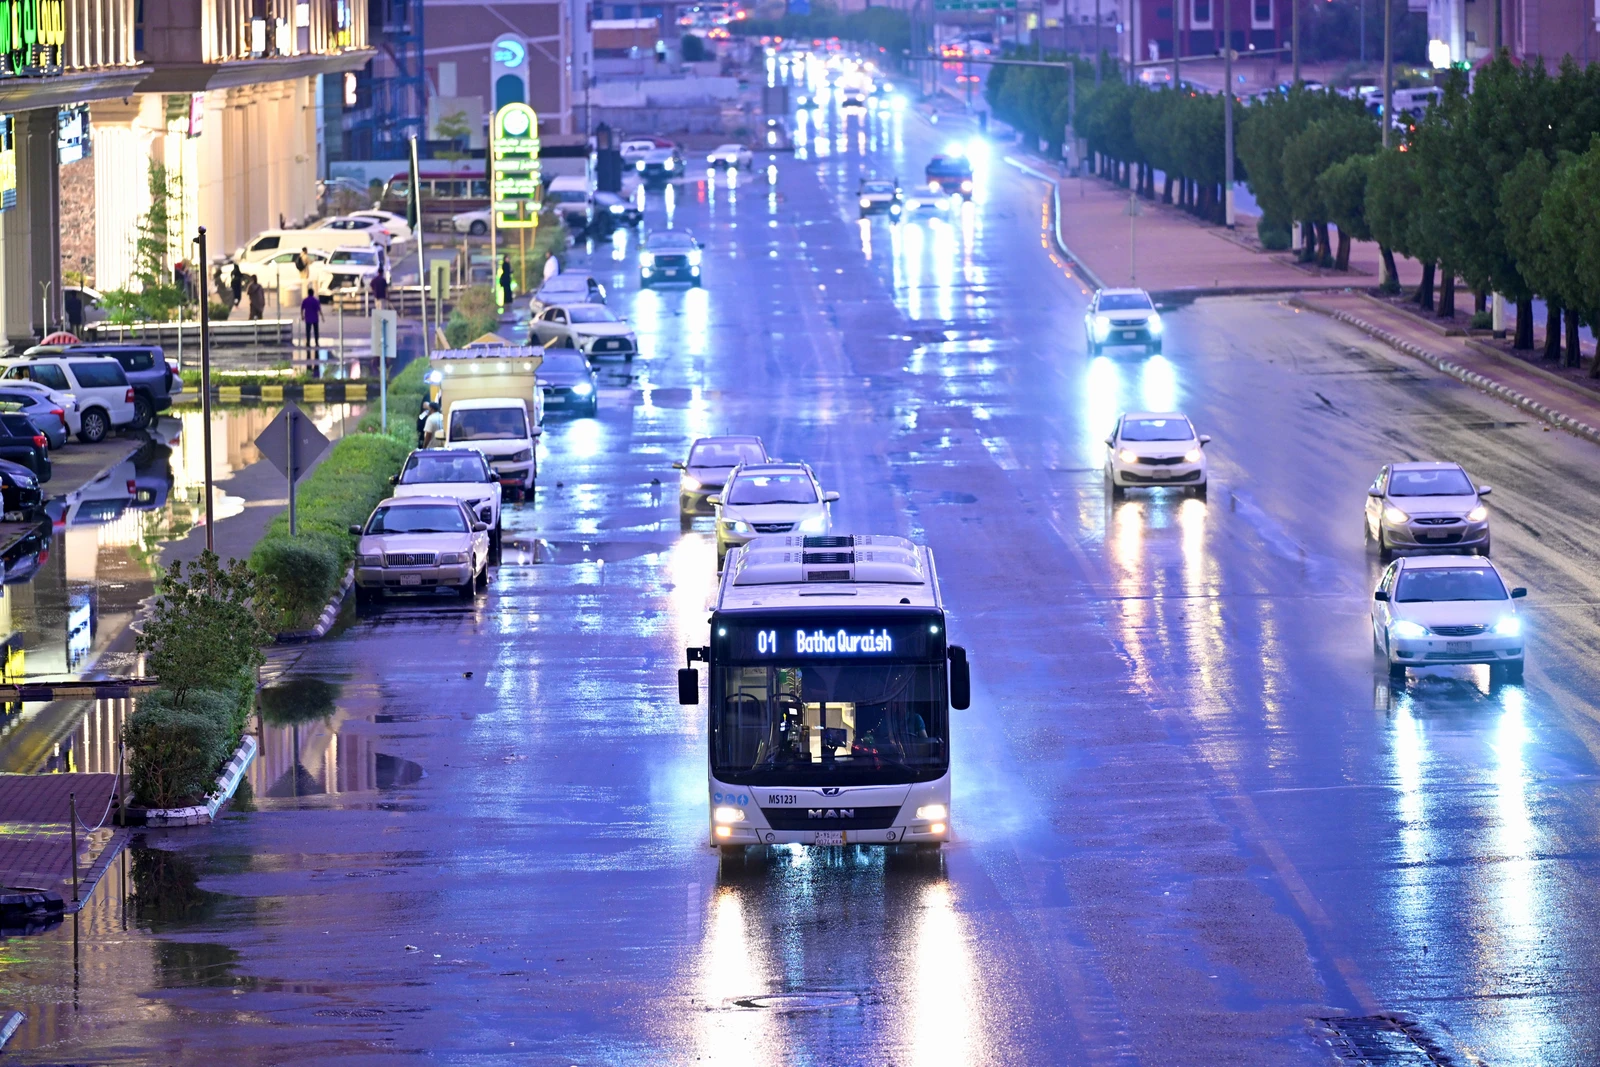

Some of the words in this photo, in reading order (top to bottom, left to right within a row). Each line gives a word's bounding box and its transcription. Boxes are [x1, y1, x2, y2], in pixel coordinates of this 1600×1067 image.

[757, 630, 777, 653] 01
[796, 630, 835, 653] Batha
[837, 629, 892, 653] Quraish
[768, 794, 798, 804] MS1231
[808, 809, 855, 819] MAN
